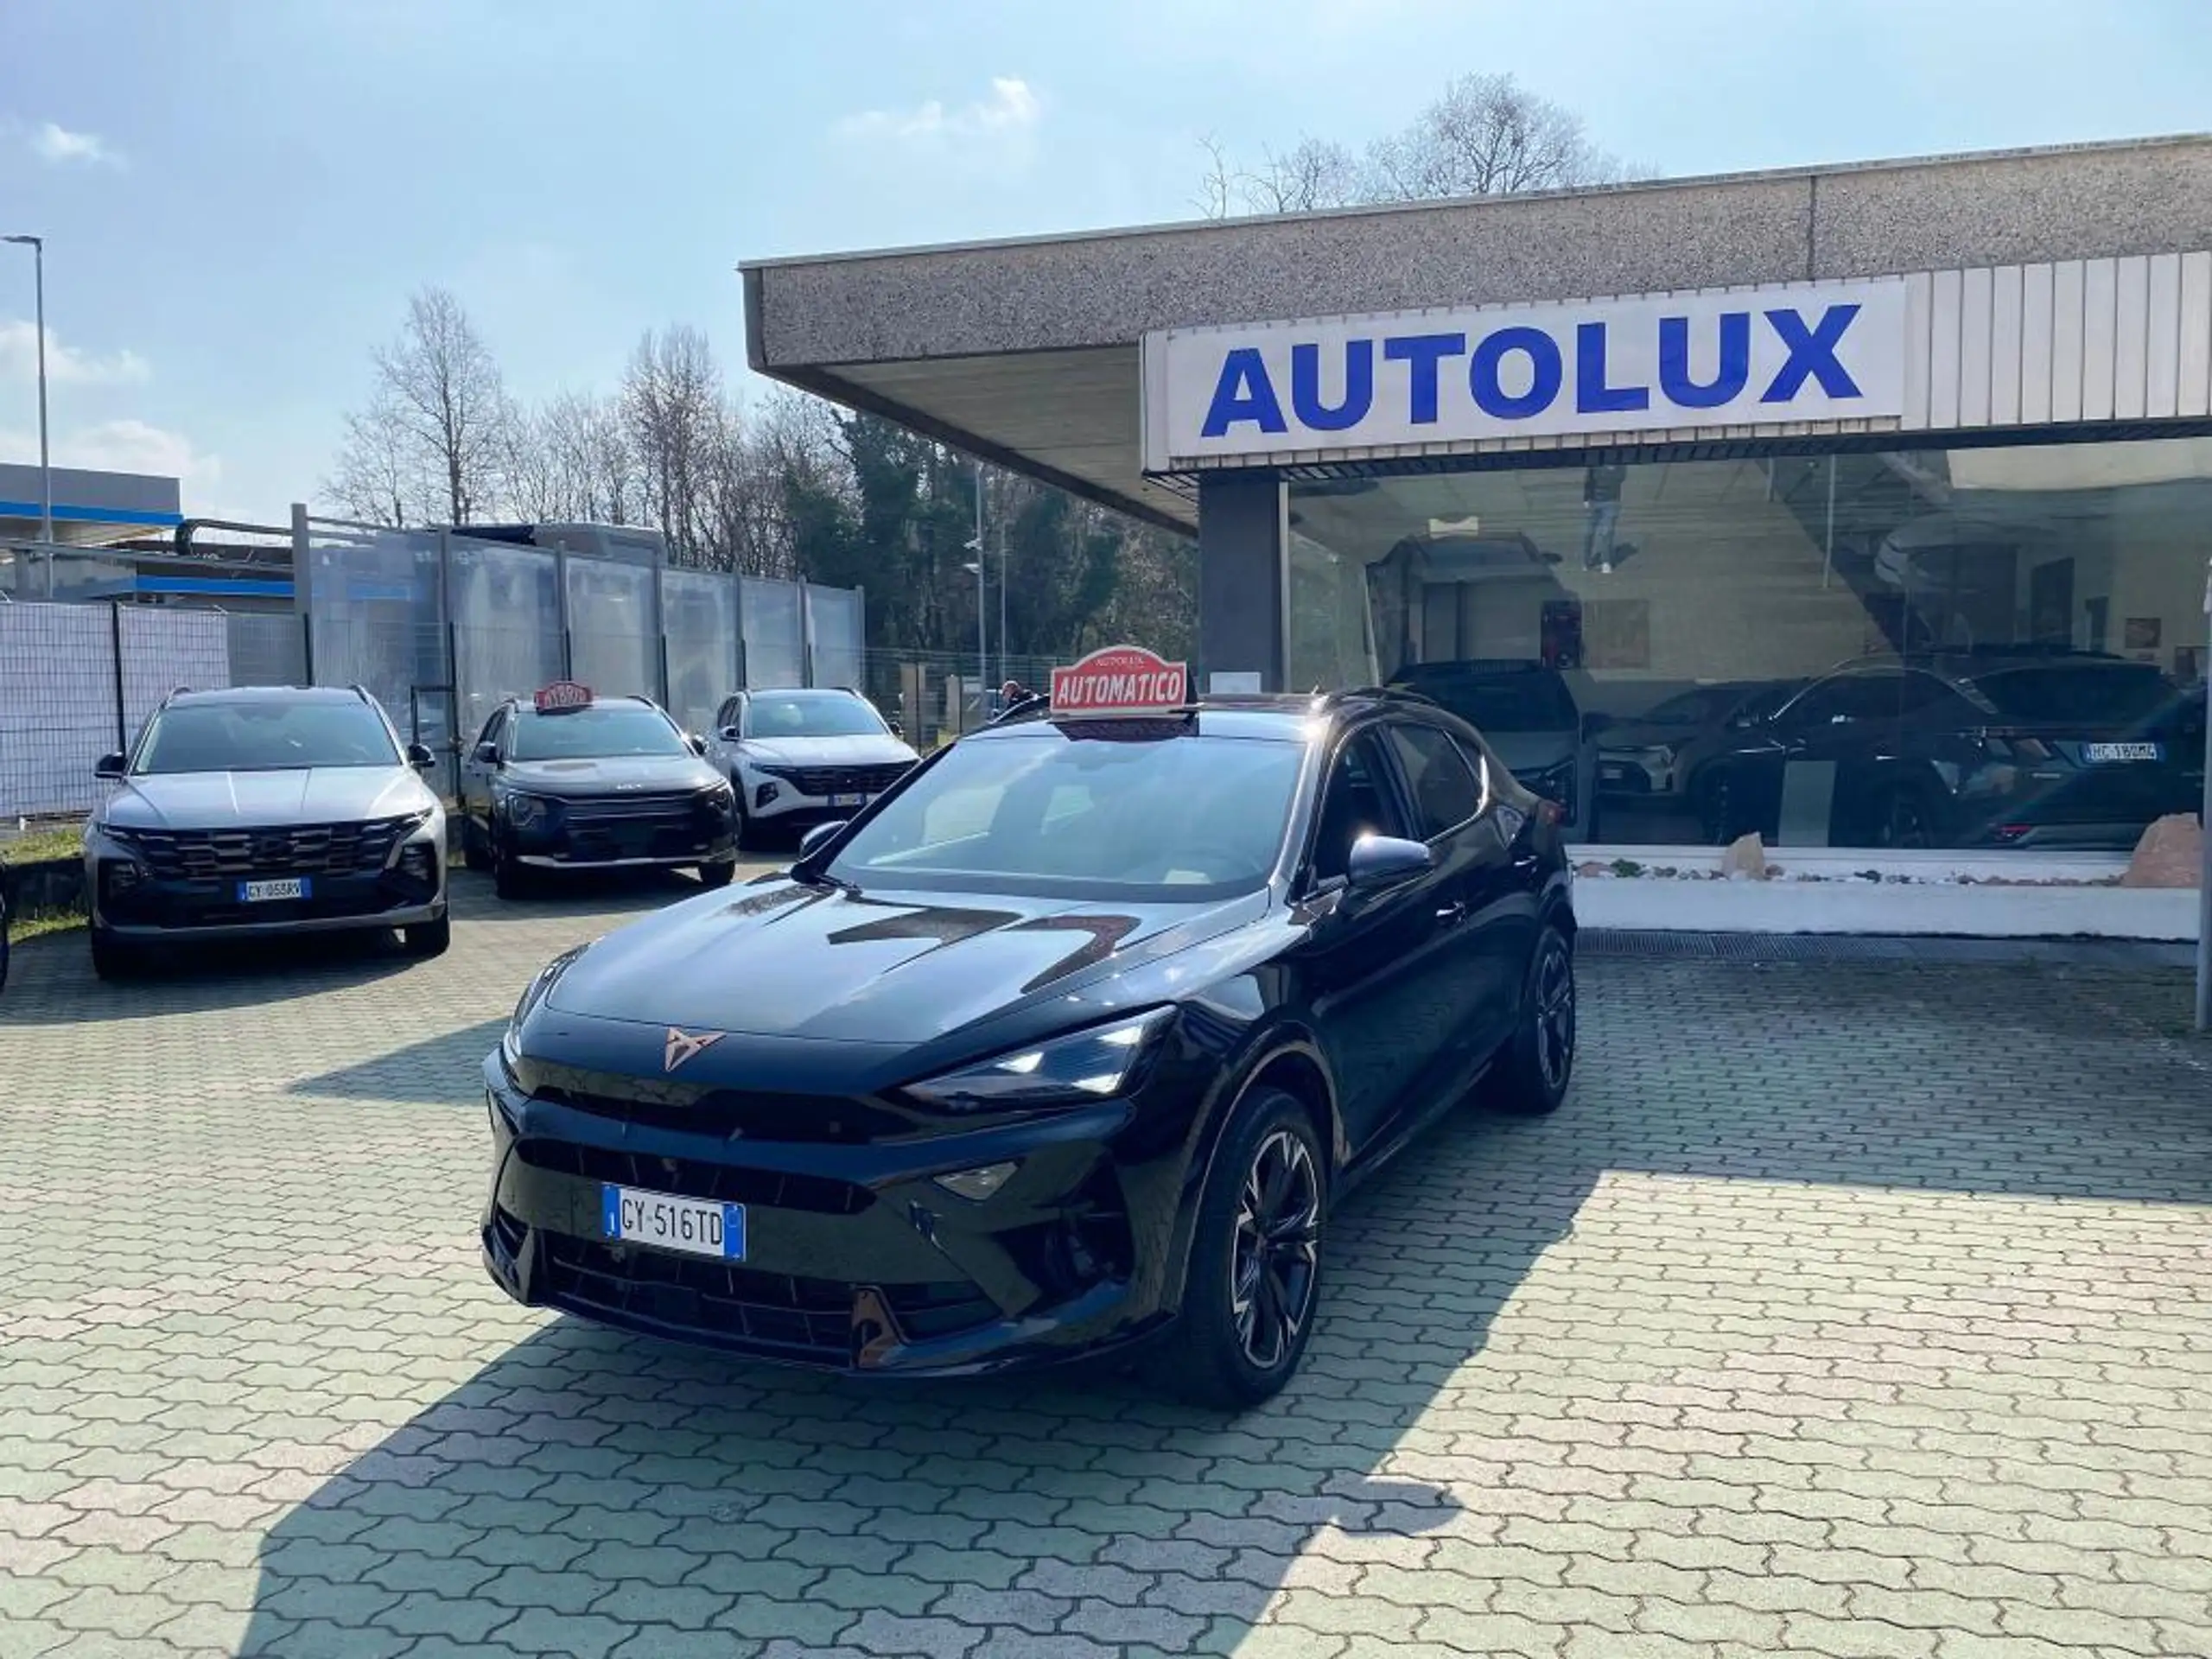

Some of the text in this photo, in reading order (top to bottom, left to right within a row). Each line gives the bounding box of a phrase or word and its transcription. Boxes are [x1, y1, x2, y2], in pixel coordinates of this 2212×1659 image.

[1201, 303, 1863, 438] AUTOLUX
[1056, 671, 1181, 705] AUTOMATICO
[654, 1204, 723, 1246] 516TD
